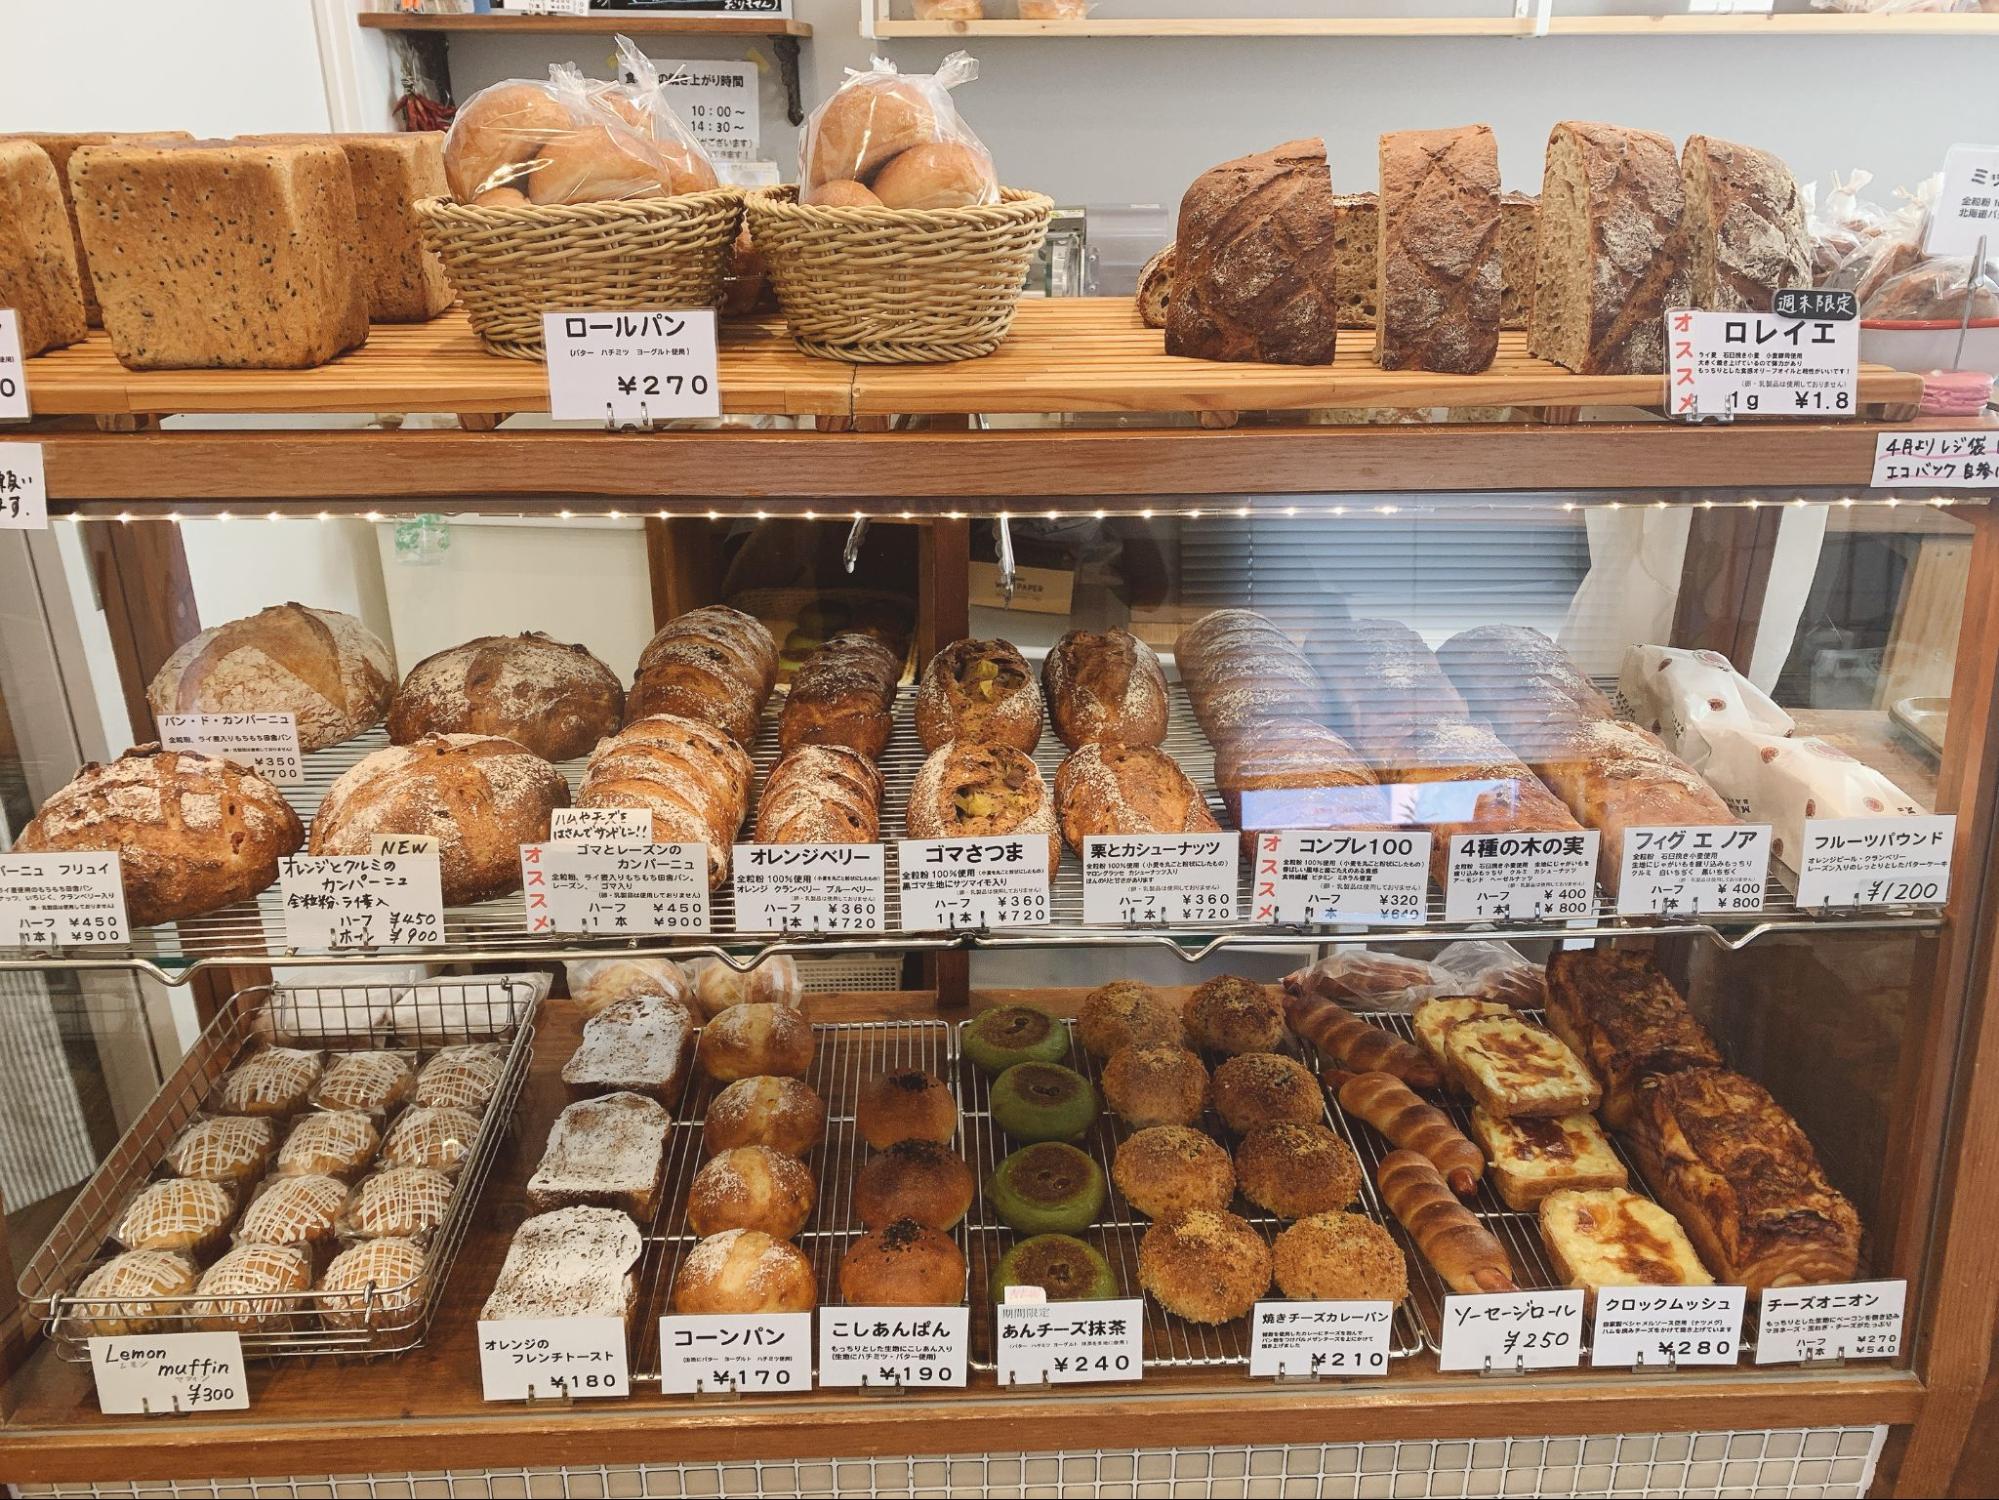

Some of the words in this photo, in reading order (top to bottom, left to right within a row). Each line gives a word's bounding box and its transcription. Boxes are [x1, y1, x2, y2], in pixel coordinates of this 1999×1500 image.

[625, 71, 744, 88] 食の焼き上がり時間
[1776, 294, 1854, 316] 週末限定
[566, 313, 685, 338] ロールパン
[1725, 319, 1836, 346] ロレイエ
[1674, 313, 1695, 412] オススメ
[617, 375, 708, 395] ¥270
[254, 757, 295, 766] ¥350
[381, 840, 428, 856] NEW
[1300, 836, 1413, 855] コンプレ100
[1460, 836, 1584, 858] 4種の木の実
[1815, 831, 1943, 849] フルーツパウンド
[577, 845, 682, 856] ゴマとレーズンの
[751, 848, 870, 865] オレンジベリー
[926, 842, 1023, 863] ゴマさつま
[1090, 841, 1220, 858] 栗とカシューナッツ
[58, 863, 109, 875] フリュイ
[283, 858, 396, 877] オレンジとクルミの
[617, 859, 694, 870] カンパーニュ
[322, 874, 408, 893] カンパーニュ
[1257, 836, 1281, 919] オススメ
[524, 847, 549, 931] オススメ
[737, 885, 768, 893] オレンジ
[1477, 891, 1510, 901] ハーフ
[1651, 885, 1684, 895] ハーフ
[1867, 880, 1938, 901] ¥1200
[935, 898, 970, 909] ハーフ
[998, 895, 1045, 907] ¥360
[1119, 896, 1155, 906] ハーフ
[1182, 894, 1230, 905] ¥360
[1308, 894, 1341, 904] ハーフ
[1379, 894, 1418, 905] ¥320
[589, 903, 627, 913] ハーフ
[653, 903, 702, 913] ¥450
[765, 903, 800, 913] ハーフ
[828, 903, 876, 914] ¥360
[998, 910, 1045, 921] ¥720
[1182, 908, 1230, 919] ¥720
[20, 918, 55, 928] ハーフ
[69, 916, 117, 927] ¥450
[340, 915, 372, 926] ハーフ
[389, 911, 436, 928] ¥450
[653, 917, 702, 927] ¥900
[828, 917, 876, 928] ¥720
[71, 930, 119, 941] ¥900
[389, 927, 438, 945] ¥900
[1606, 1298, 1730, 1311] クロックムッシュ
[1768, 1294, 1879, 1312] チーズオニオン
[1262, 1311, 1389, 1325] 焼きチーズカレーパン
[1455, 1300, 1576, 1327] ソーセージロール
[674, 1326, 785, 1346] コーンパン
[832, 1320, 950, 1337] こしあんぱん
[1002, 1319, 1127, 1339] あんチーズ抹茶
[485, 1338, 549, 1350] オレンジの
[1504, 1330, 1569, 1354] ¥250
[1658, 1341, 1730, 1355] ¥280
[1796, 1338, 1826, 1347] ハーフ
[1857, 1334, 1897, 1343] ¥270
[105, 1344, 166, 1363] Lemon
[1856, 1345, 1896, 1353] ¥540
[512, 1351, 614, 1364] フレンチトースト
[1054, 1355, 1130, 1373] ¥240
[1311, 1352, 1383, 1367] ¥210
[158, 1358, 229, 1377] muffin
[880, 1367, 952, 1381] ¥190
[550, 1374, 616, 1388] ¥180
[713, 1370, 790, 1385] ¥170
[187, 1383, 234, 1405] ¥300
